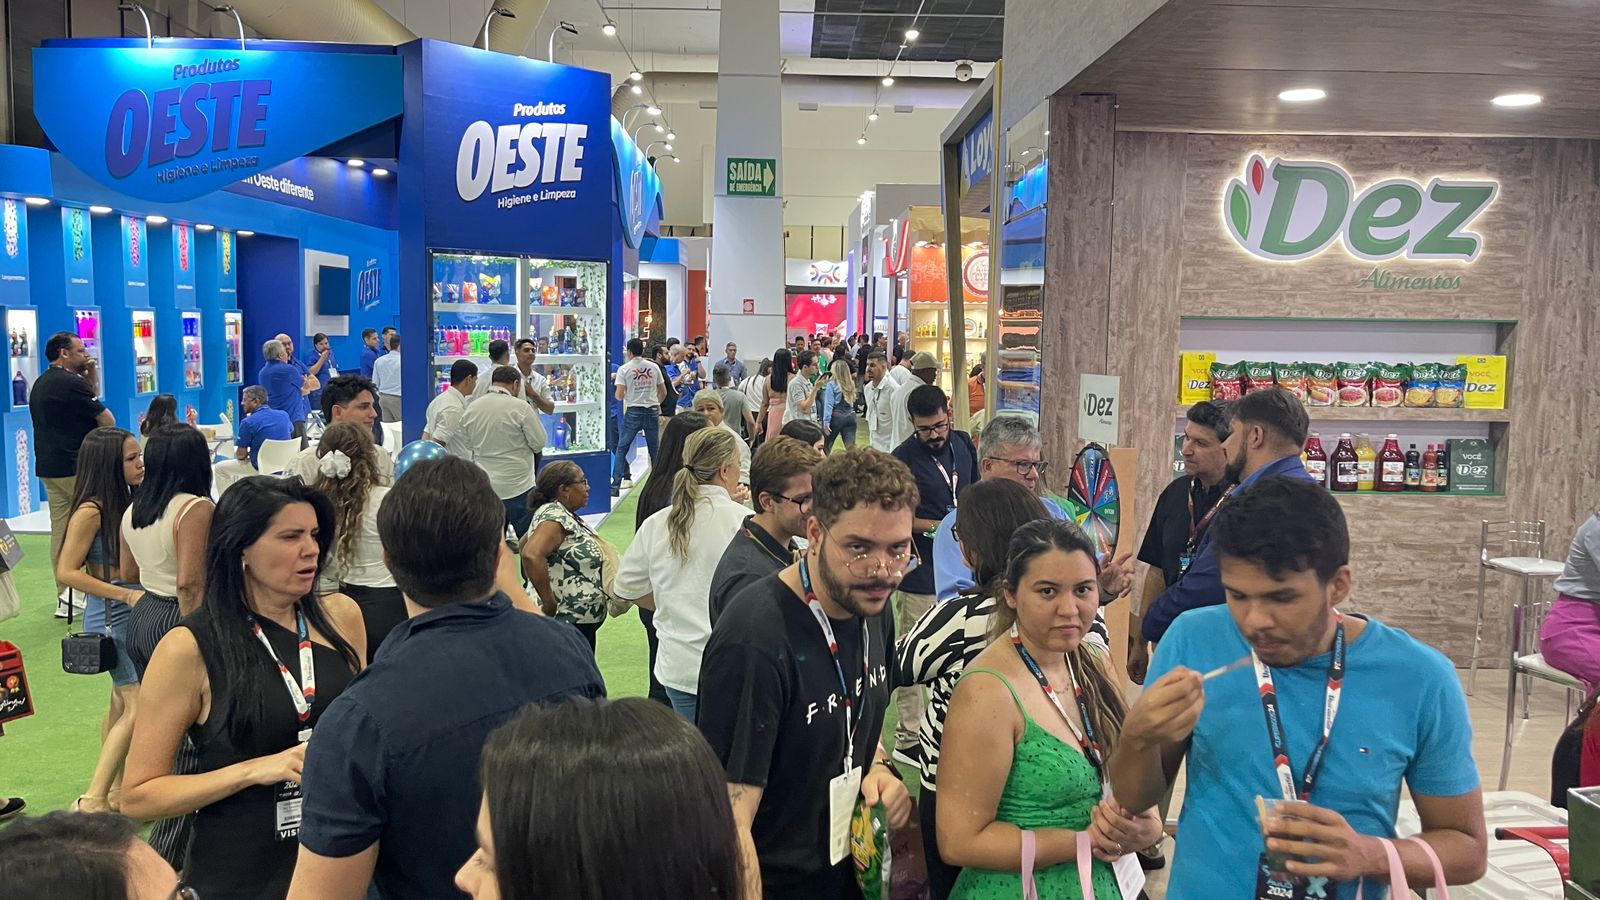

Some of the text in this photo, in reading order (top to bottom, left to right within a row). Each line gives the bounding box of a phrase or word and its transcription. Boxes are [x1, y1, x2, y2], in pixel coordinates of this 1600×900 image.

[173, 58, 240, 80] Produtos
[513, 102, 566, 116] Produtos
[104, 79, 272, 179] OESTE
[156, 155, 259, 184] Higiene e Limpeza
[456, 120, 588, 201] OESTE
[729, 160, 762, 181] SAÍDA
[254, 173, 280, 192] Oeste
[280, 178, 315, 201] diferente
[497, 189, 576, 208] Higiene e Limpeza
[1258, 162, 1494, 257] Dez
[1356, 267, 1462, 290] Alimentos
[1190, 380, 1210, 390] Dez
[1467, 382, 1496, 392] Dez
[1087, 393, 1115, 416] Dez
[1459, 464, 1488, 475] Dez
[1266, 885, 1294, 899] 2024
